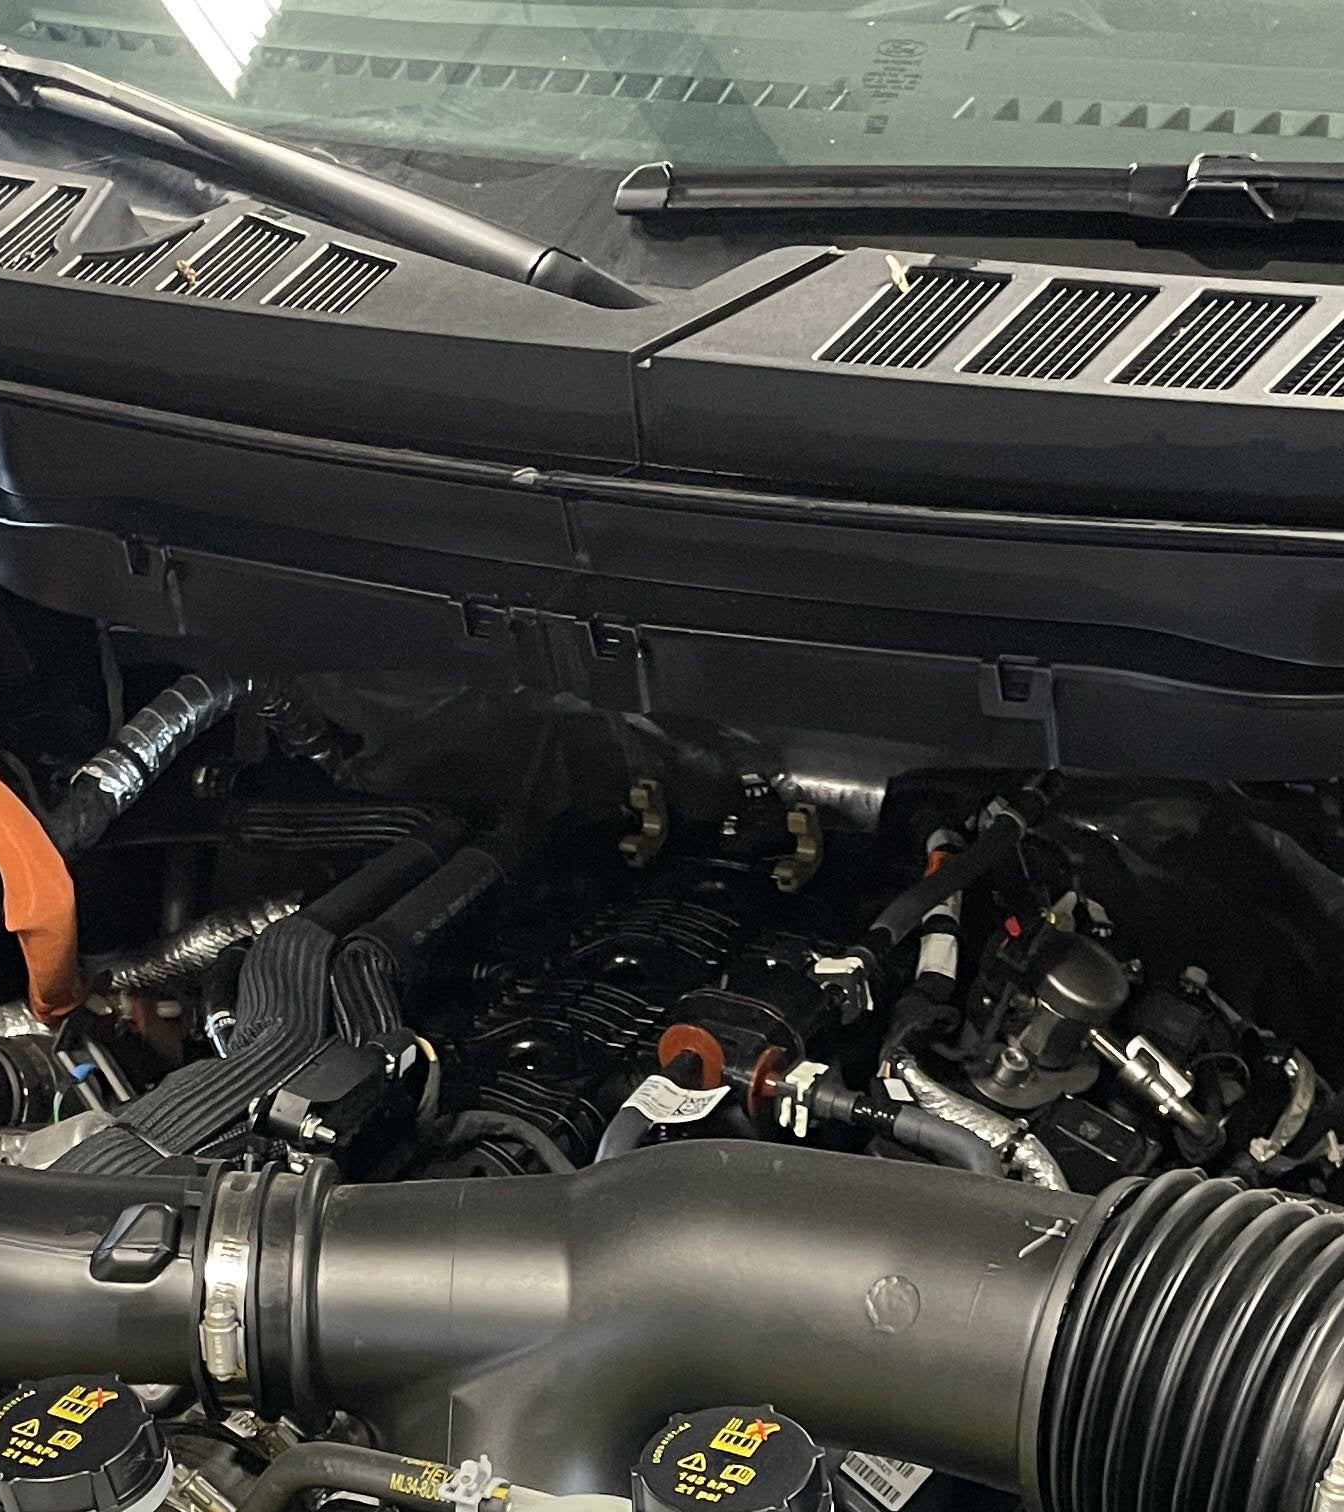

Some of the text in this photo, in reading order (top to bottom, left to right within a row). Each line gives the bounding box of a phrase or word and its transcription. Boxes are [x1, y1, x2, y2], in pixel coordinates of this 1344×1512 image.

[9, 1436, 35, 1450] 145
[1, 1448, 22, 1460] 21
[678, 1471, 706, 1485] 145
[674, 1483, 696, 1495] 21
